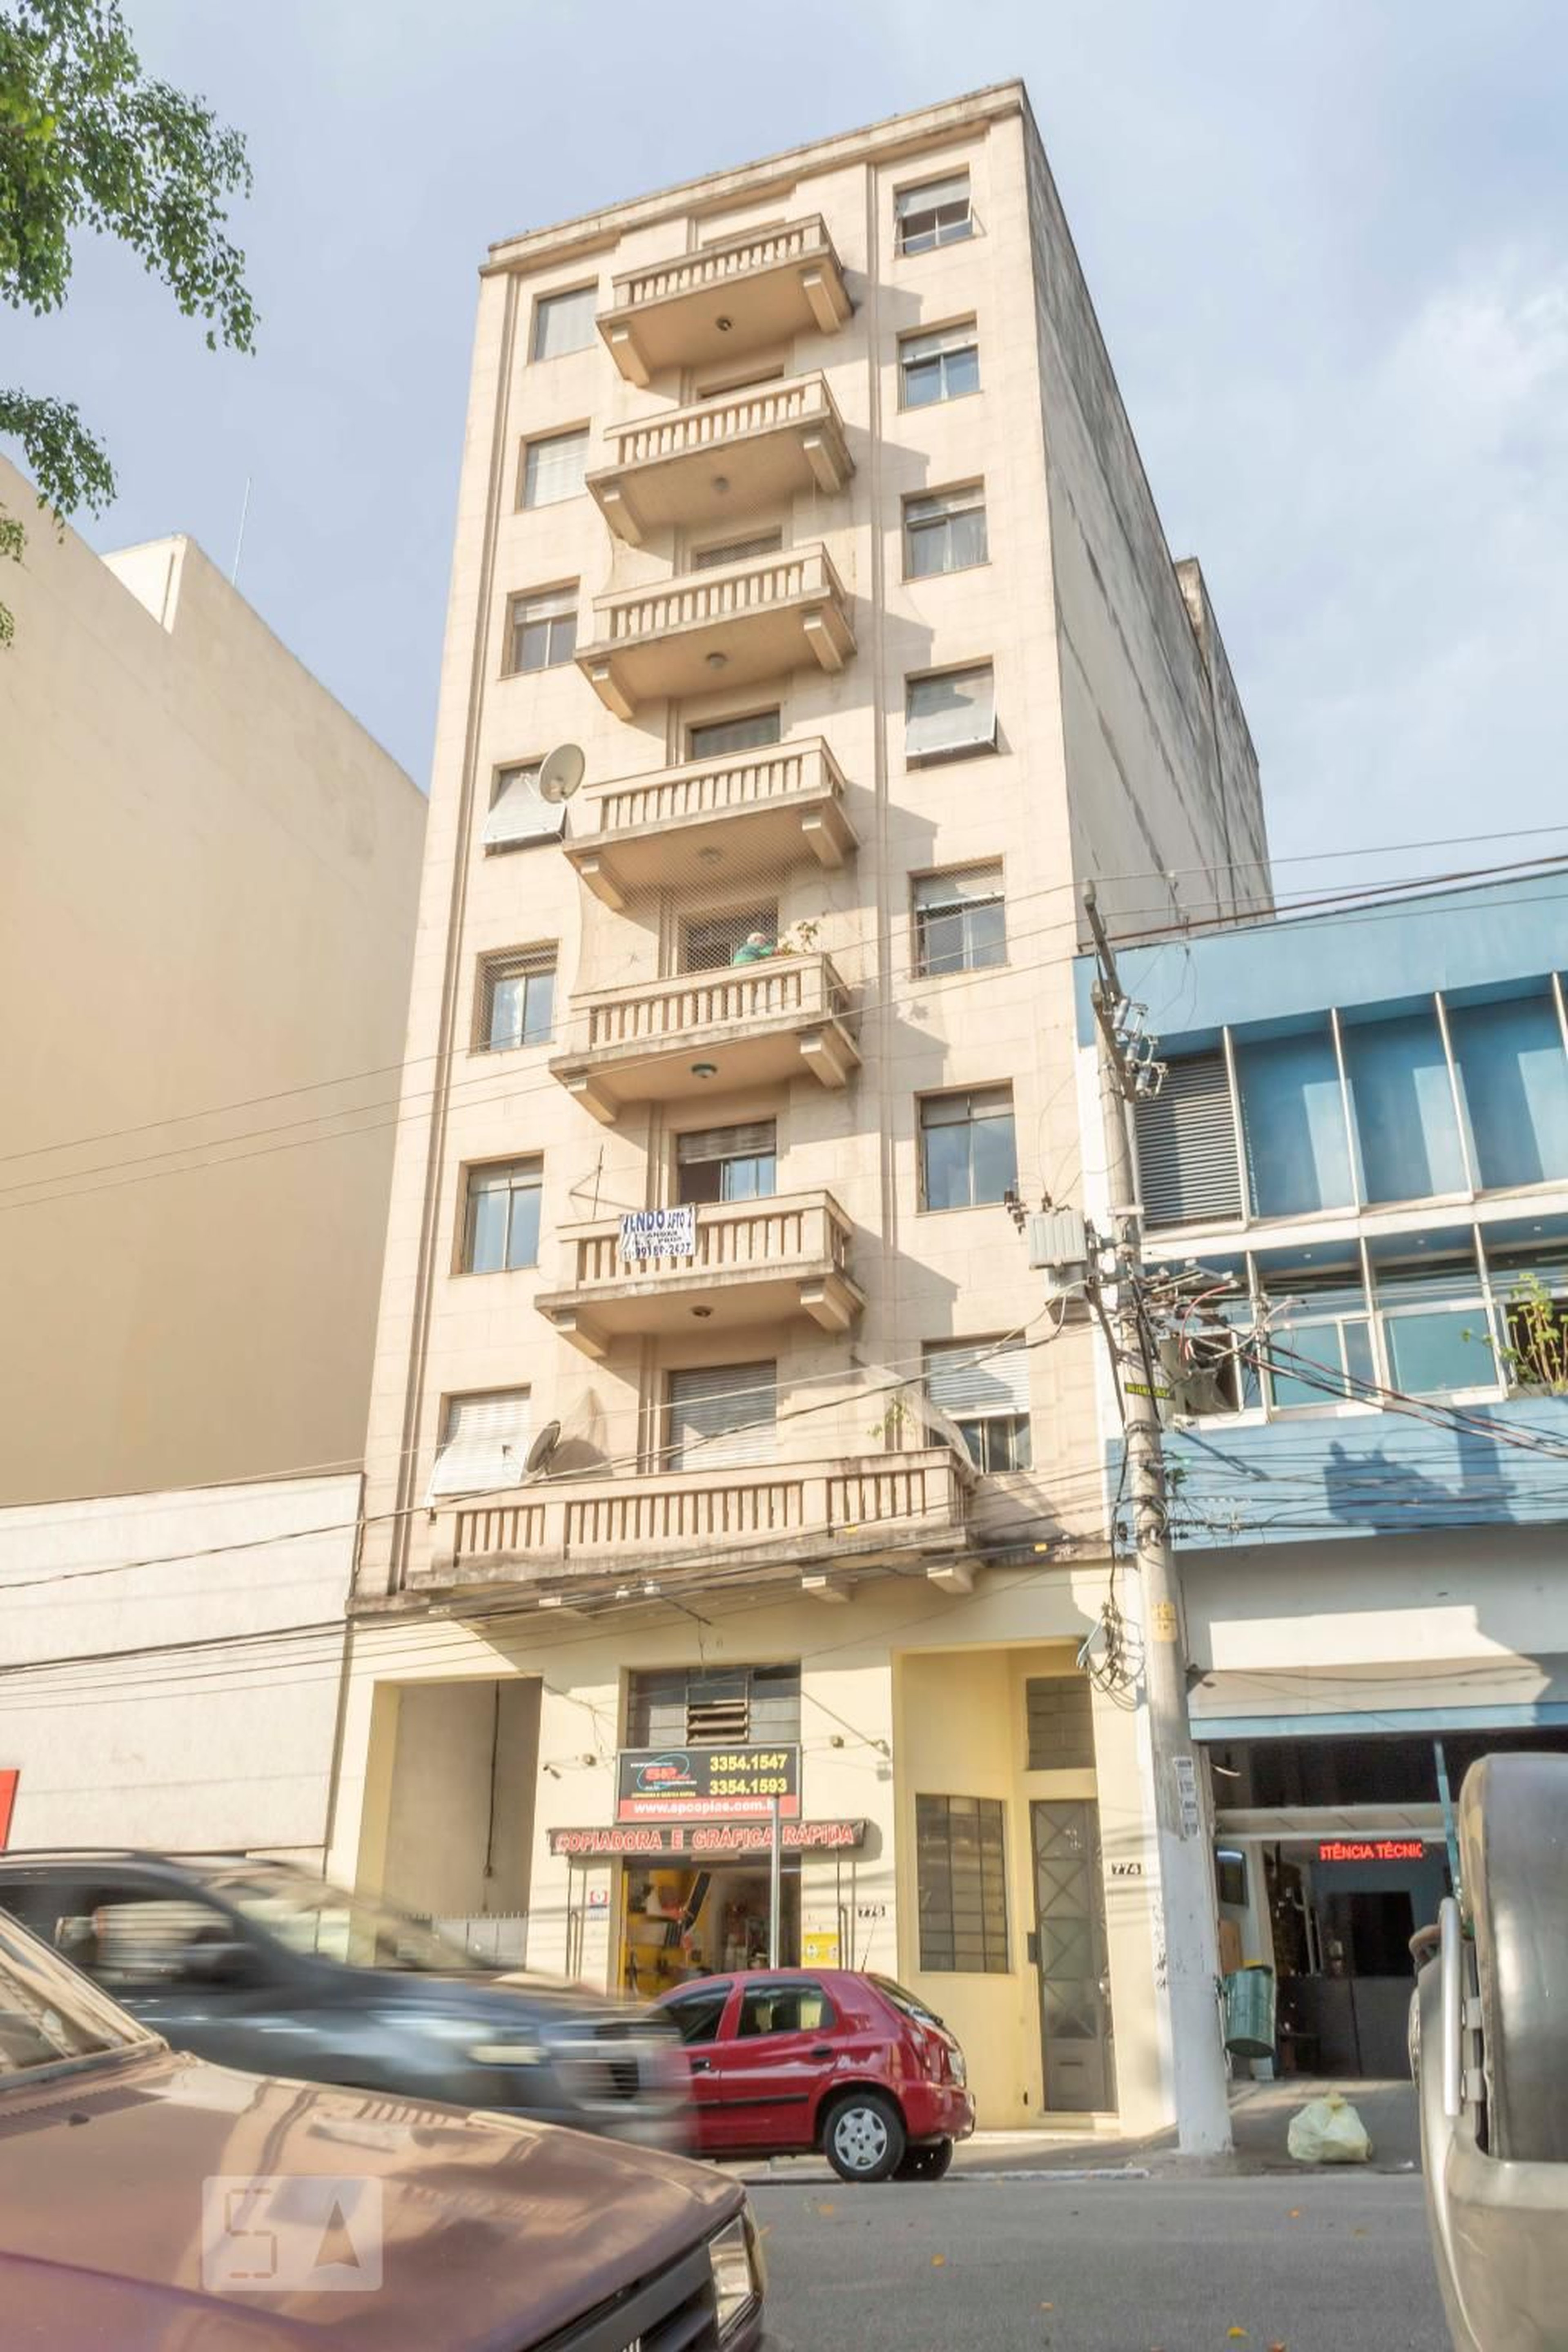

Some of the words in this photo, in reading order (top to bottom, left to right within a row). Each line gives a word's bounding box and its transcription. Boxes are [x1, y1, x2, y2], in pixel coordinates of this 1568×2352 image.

[710, 1753, 788, 1772] 3354.1547
[710, 1777, 787, 1795] 3354.1593
[555, 1830, 662, 1851] COPIADORA
[671, 1826, 684, 1851] E
[693, 1825, 773, 1849] GRÁFICA
